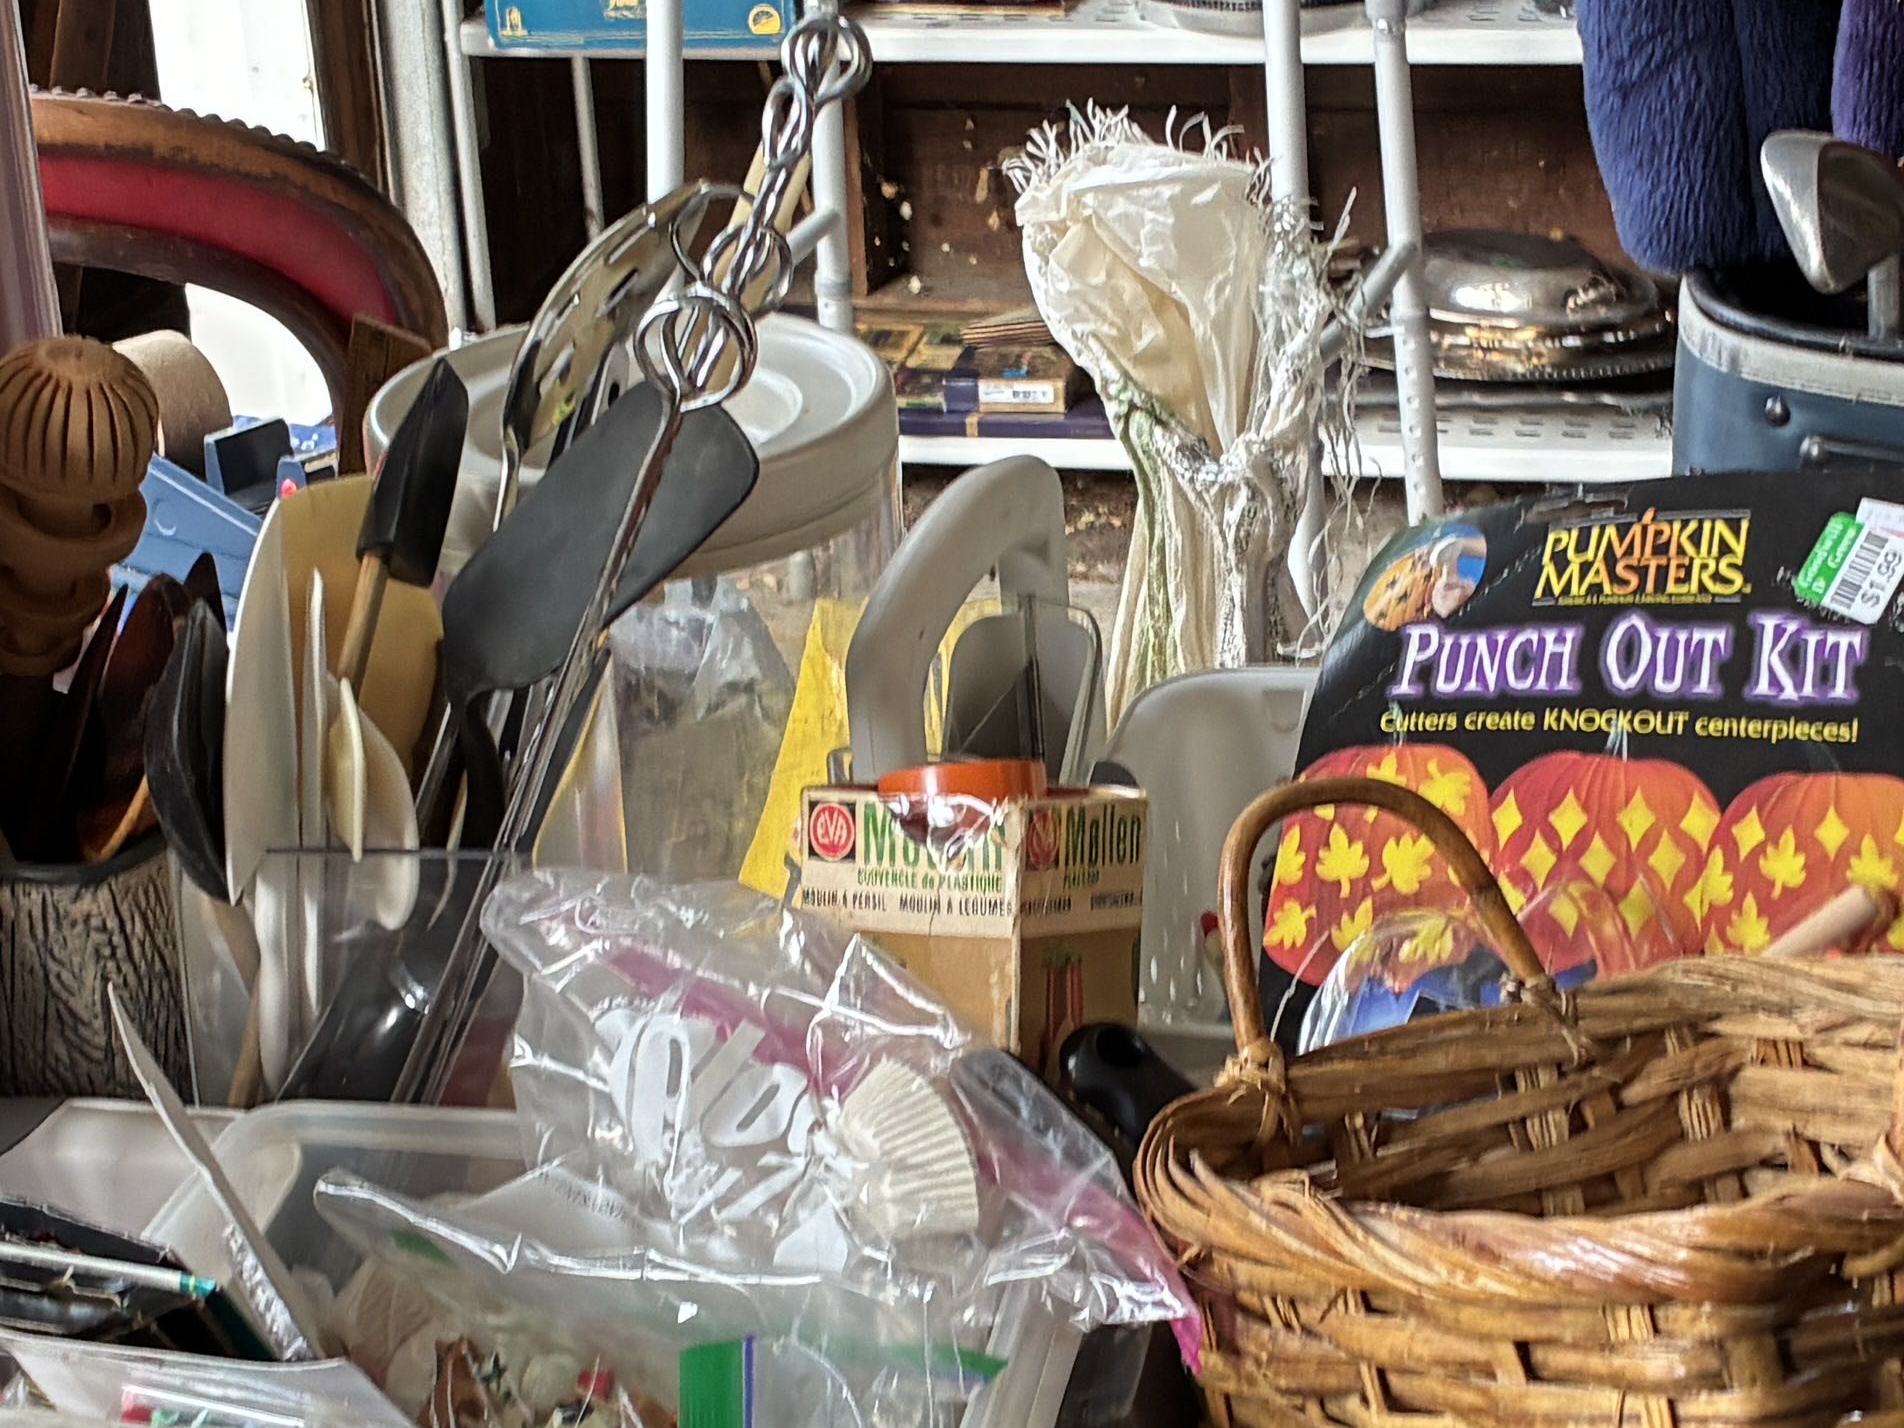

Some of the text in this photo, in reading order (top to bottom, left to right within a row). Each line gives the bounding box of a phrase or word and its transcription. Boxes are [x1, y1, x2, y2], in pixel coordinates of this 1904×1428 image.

[1542, 514, 1750, 566] PUMPKIN
[1391, 613, 1863, 701] PUNCH OUT KIT
[1380, 708, 1860, 745] Cutters create KNOCKOUT centerpieces!
